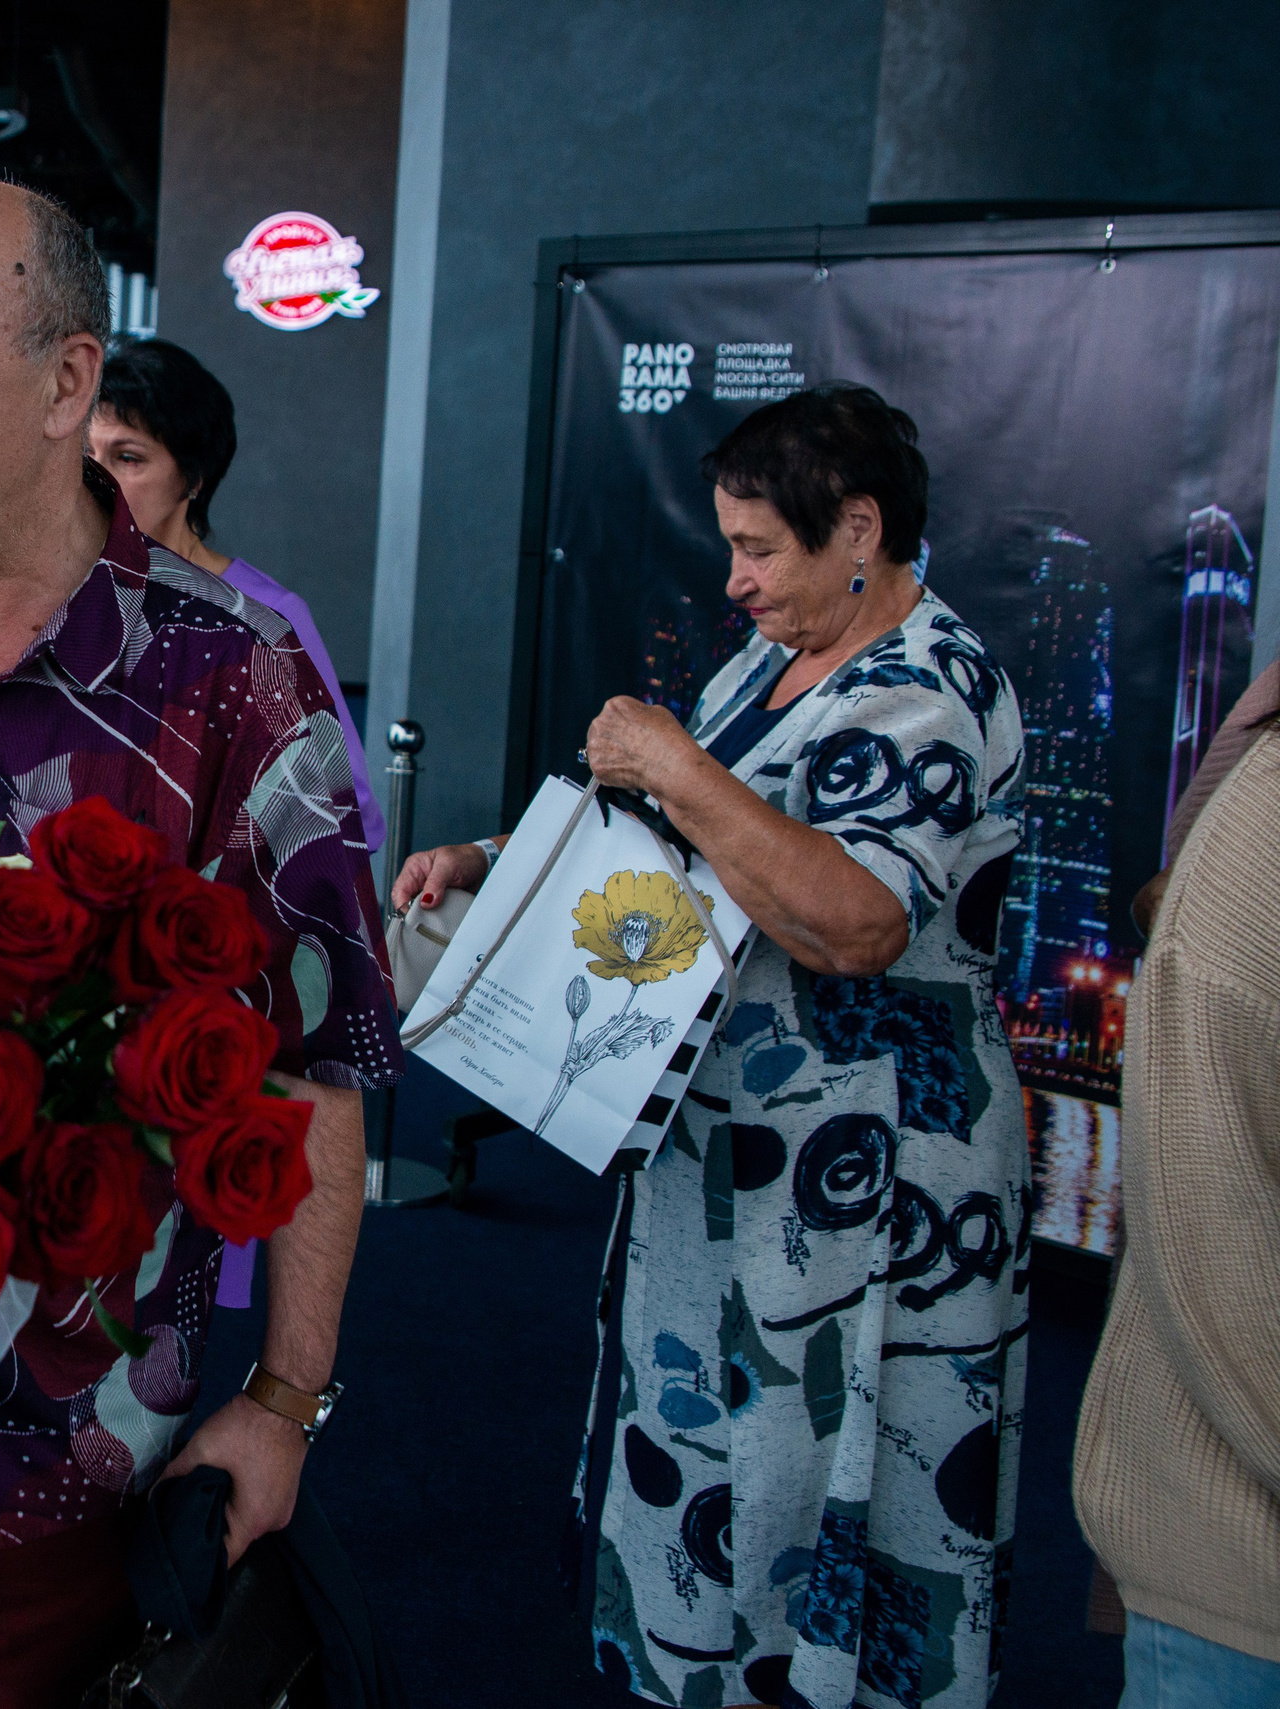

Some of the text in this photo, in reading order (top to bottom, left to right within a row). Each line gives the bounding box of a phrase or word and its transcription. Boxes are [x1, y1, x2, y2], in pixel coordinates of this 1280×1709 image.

[624, 343, 694, 366] PANO
[716, 343, 792, 356] СМОТРОВАЯ
[715, 358, 791, 371] ПЛОЩАДКА
[622, 366, 692, 388] RAMA
[714, 372, 805, 385] МОСКВА-СИТИ
[618, 388, 673, 413] 360
[713, 387, 758, 400] БАШНЯ
[472, 999, 496, 1016] глазах
[499, 986, 535, 1012] женщины
[491, 994, 509, 1010] быть
[510, 1008, 532, 1025] видна
[441, 1023, 477, 1051] ЮБОВЬ.
[460, 1055, 478, 1070] Одри
